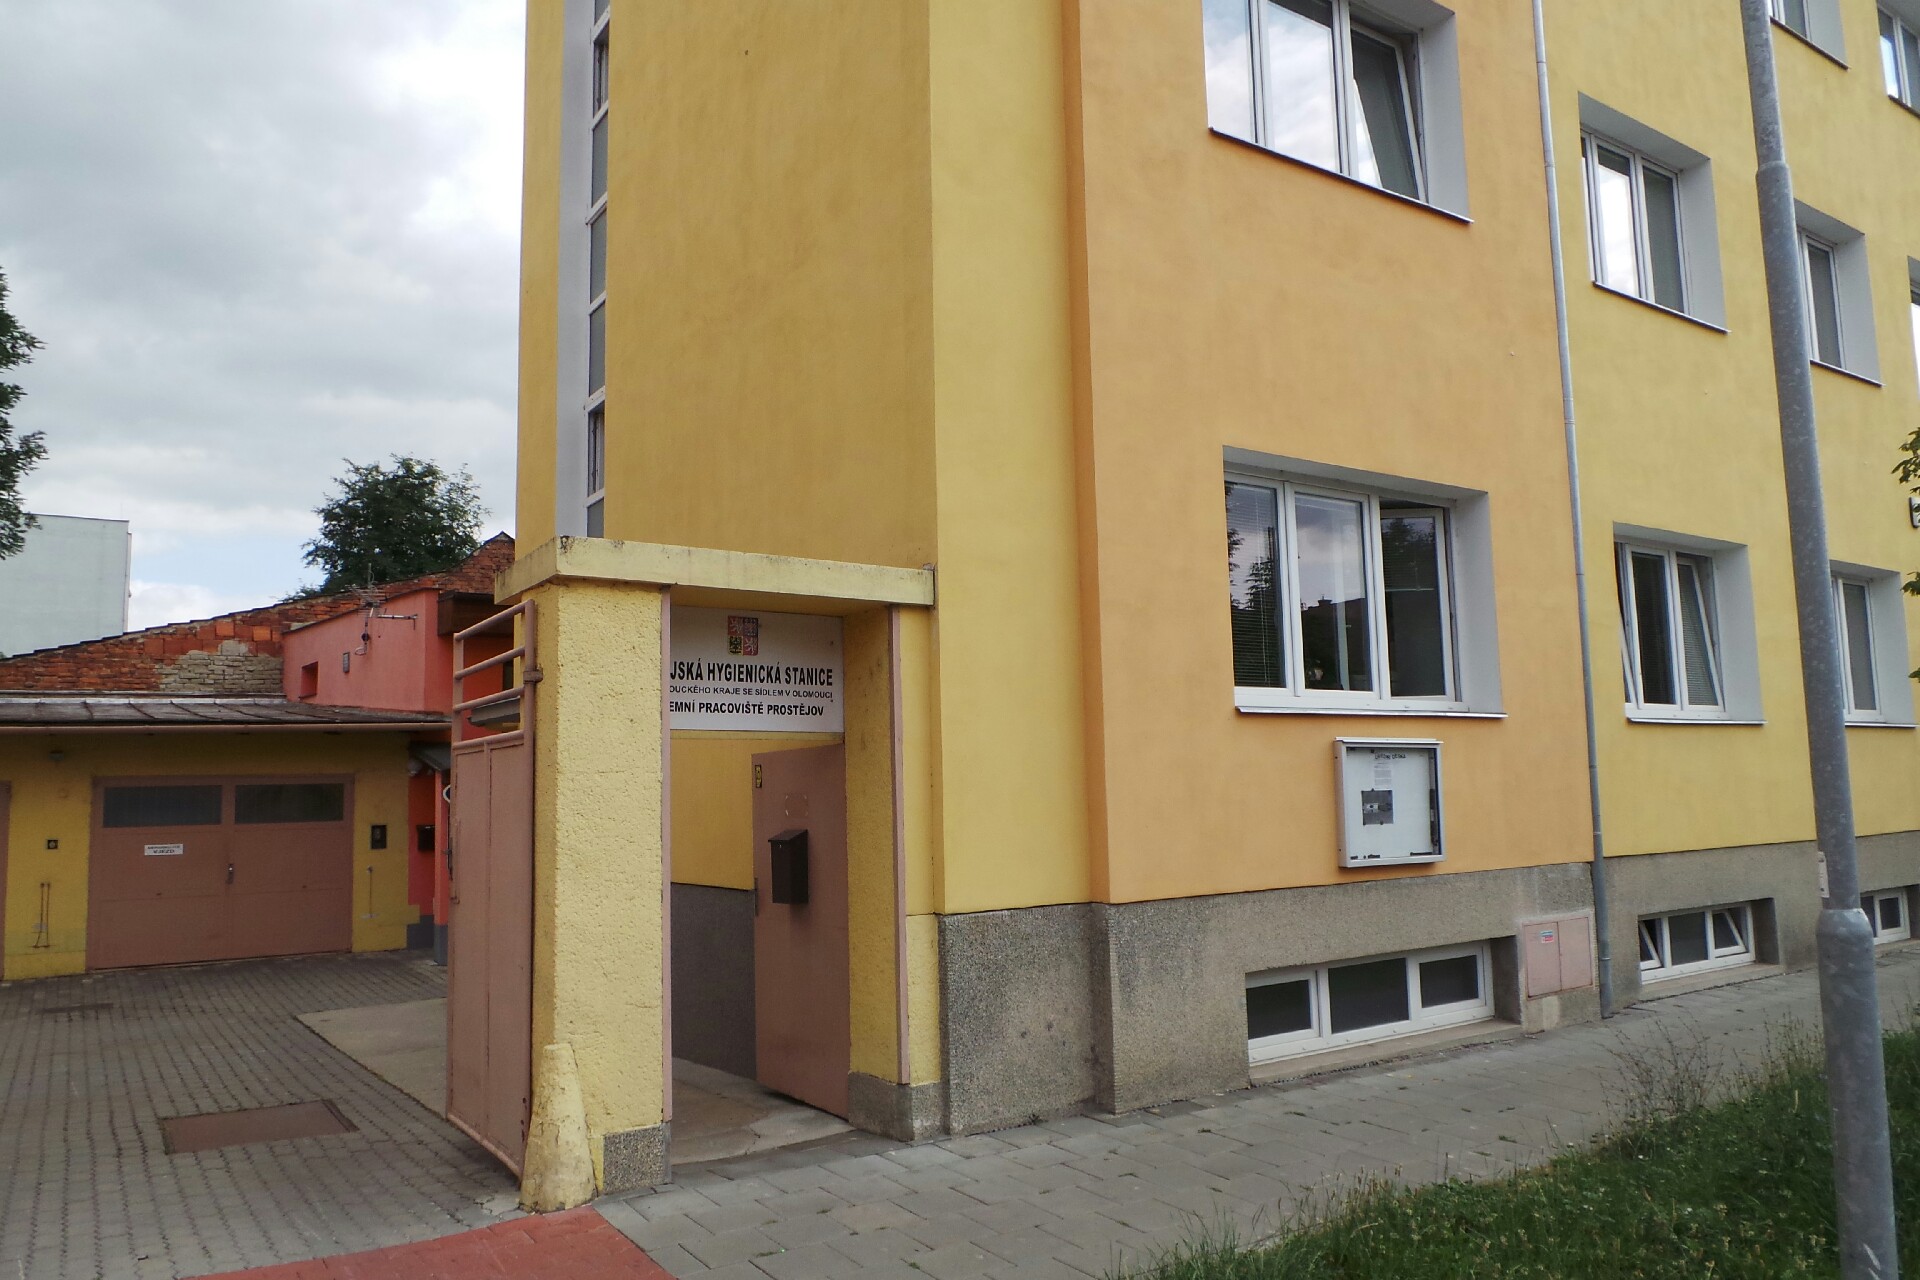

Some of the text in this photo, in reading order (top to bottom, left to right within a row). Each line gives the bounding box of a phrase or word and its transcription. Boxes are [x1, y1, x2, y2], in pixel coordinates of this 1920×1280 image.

[708, 661, 781, 684] HYGIENICKÁ
[785, 666, 833, 686] STANICE
[713, 687, 740, 695] KRAJE
[755, 687, 783, 696] SÍDLEM
[792, 690, 832, 699] OLOMOUCI
[699, 701, 763, 714] PRACOVIŠTĚ
[767, 703, 824, 716] PROSTĚJOV
